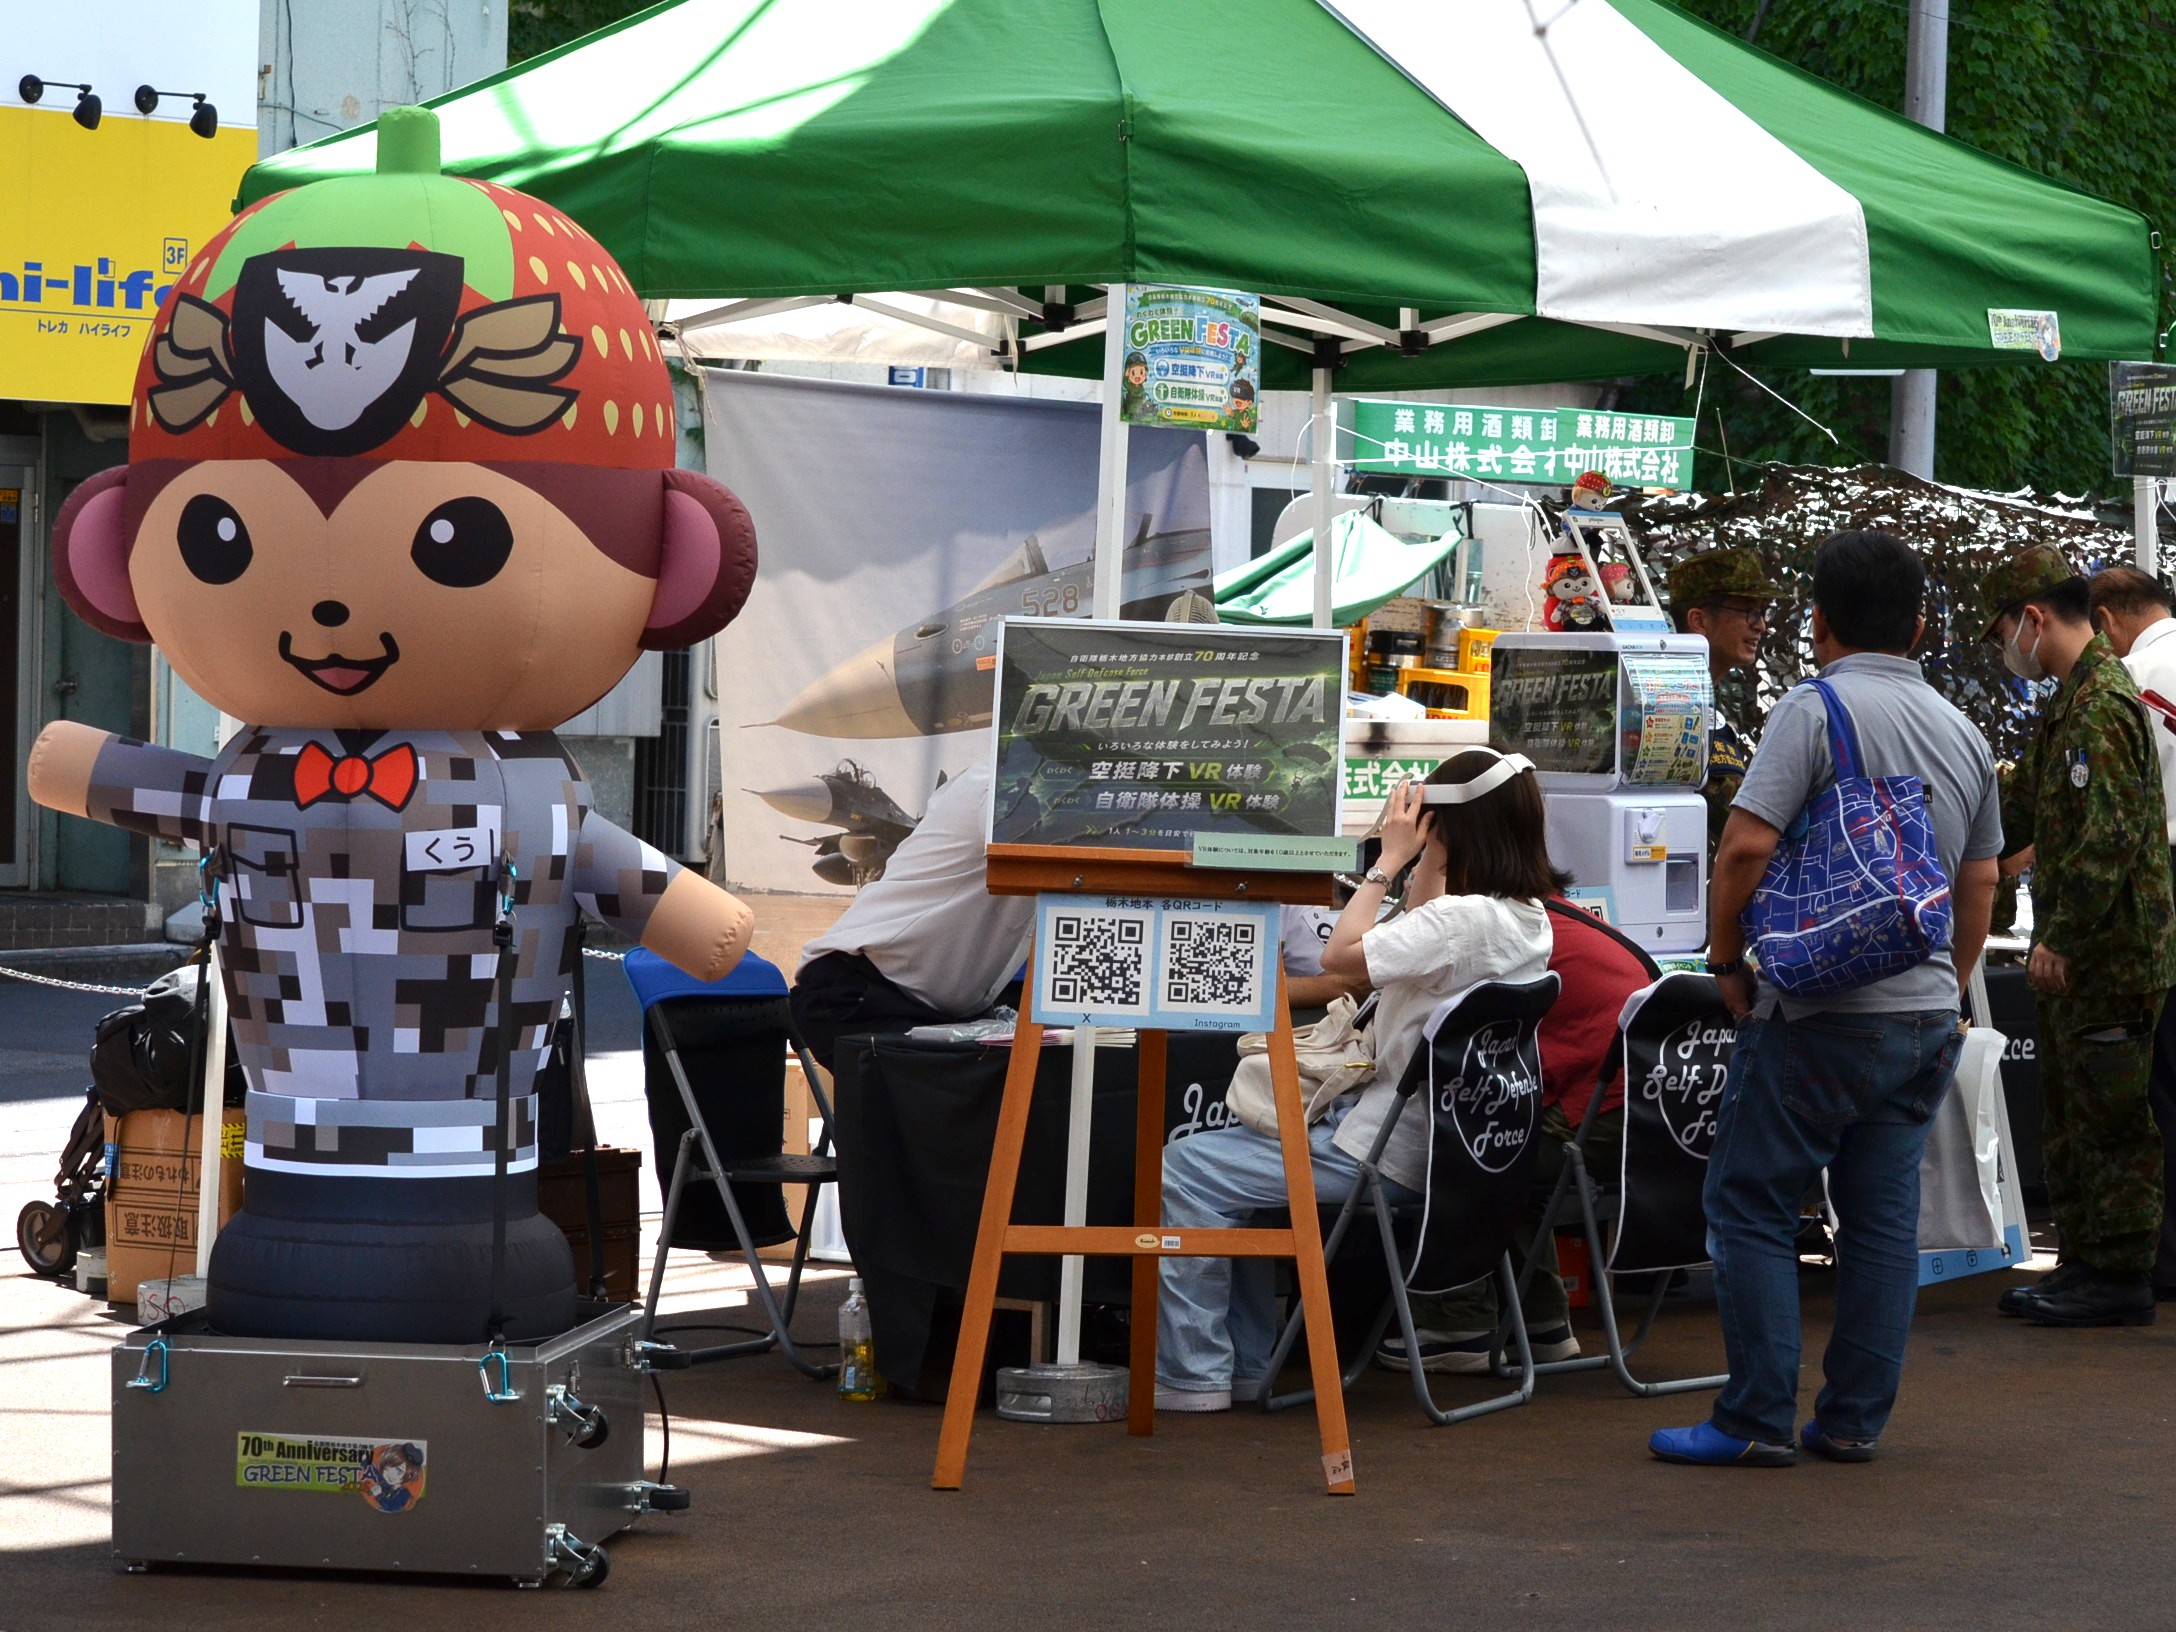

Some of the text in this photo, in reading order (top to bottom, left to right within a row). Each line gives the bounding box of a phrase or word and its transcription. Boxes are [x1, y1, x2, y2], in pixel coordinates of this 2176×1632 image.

[166, 246, 185, 264] 3F
[38, 319, 131, 337] トレカ ハイライフ
[1130, 314, 1250, 357] GREEN FESTA
[2117, 388, 2151, 416] GREEN
[1577, 413, 1675, 445] 業務用酒類卸
[1563, 442, 1679, 484] 中山株式会社
[1021, 584, 1079, 616] 528
[1065, 668, 1086, 679] Self
[1087, 667, 1123, 678] Defense
[1125, 666, 1149, 676] Force
[1497, 675, 1557, 706] GREEN
[1556, 670, 1611, 705] FESTA
[1010, 674, 1325, 736] GREEN FESTA
[1560, 722, 1574, 732] VR
[1098, 739, 1249, 751] いろいろな体験をしてみよう!
[1089, 760, 1184, 780] 空挺降下
[1189, 762, 1222, 780] VR
[1226, 763, 1262, 780] 体験
[1095, 791, 1202, 810] 自衛隊体操
[1209, 793, 1242, 810] VR
[1245, 794, 1280, 810] 体験
[424, 836, 475, 864] くう
[1105, 898, 1223, 912] 栃木地本 各QRコード
[1082, 1013, 1241, 1029] X Instagram
[1473, 1120, 1524, 1158] Force
[120, 1162, 190, 1184] われもの注意
[124, 1211, 190, 1241] 取扱注意
[240, 1436, 374, 1465] 70th Anniversary
[243, 1464, 378, 1484] GREEN FESTA
